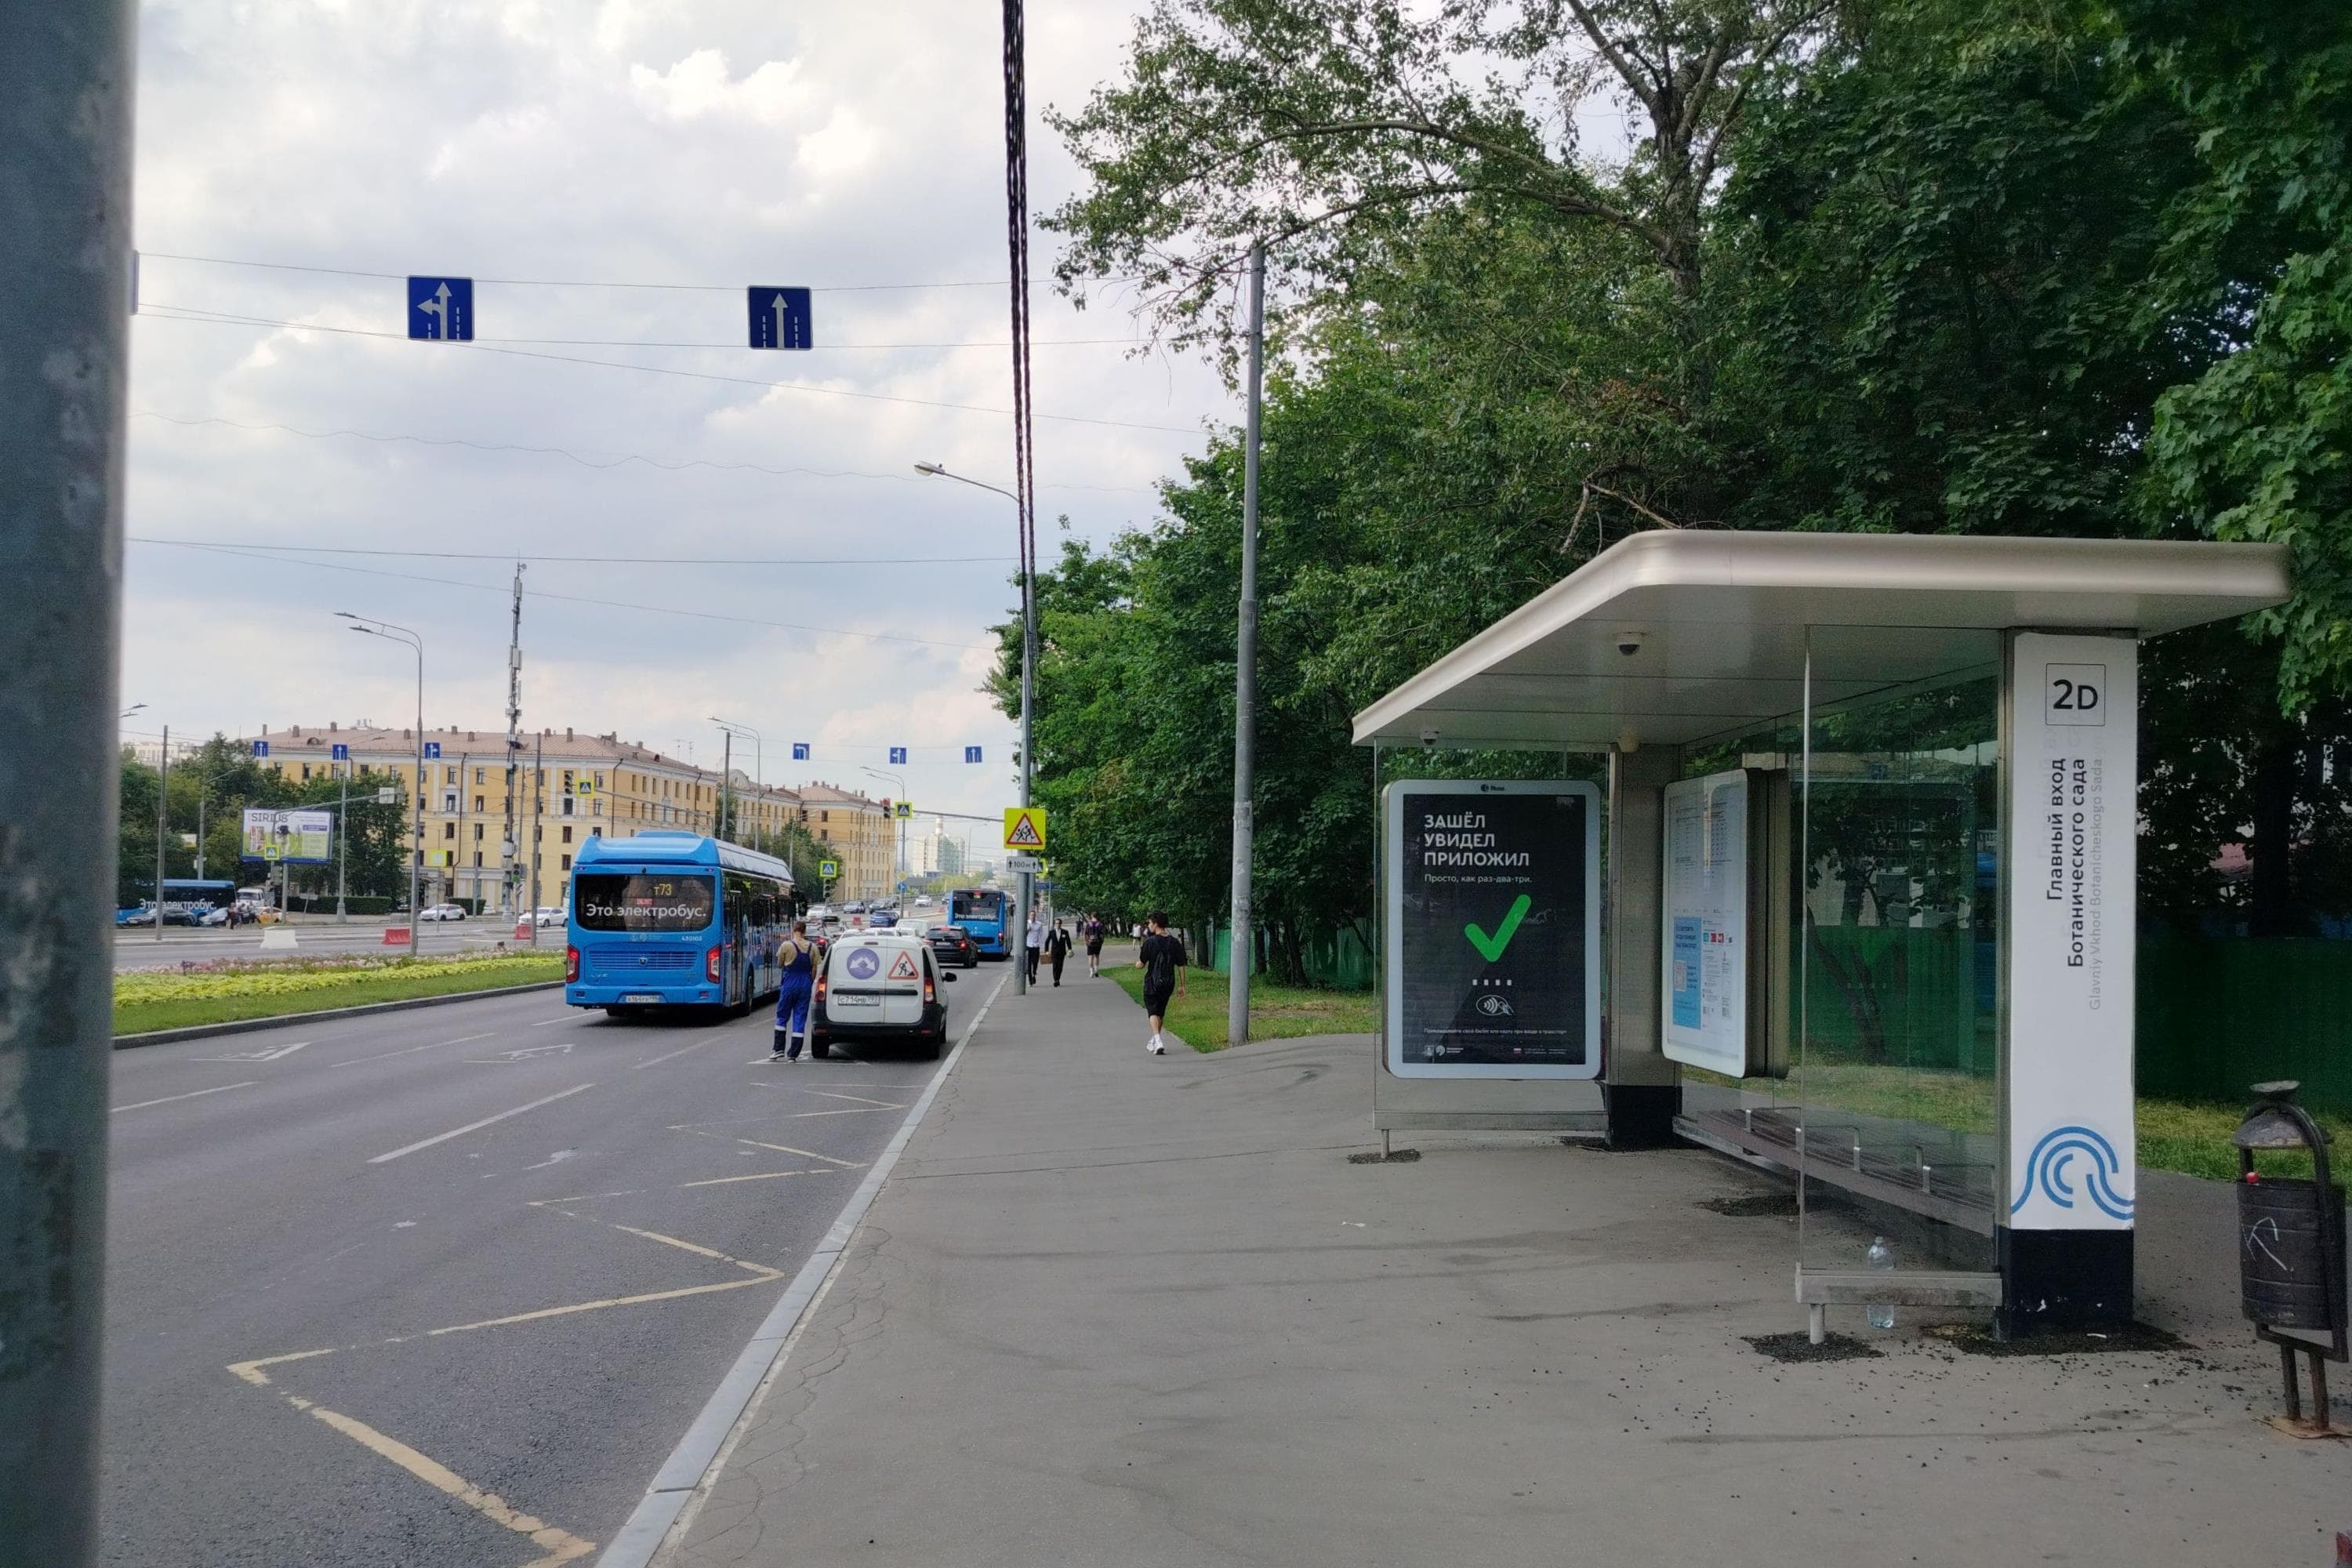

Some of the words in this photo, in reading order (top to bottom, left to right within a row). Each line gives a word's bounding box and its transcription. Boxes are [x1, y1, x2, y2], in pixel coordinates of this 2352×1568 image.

[2053, 679, 2098, 710] 2D
[2052, 758, 2066, 806] вход
[2073, 759, 2087, 806] сада
[2091, 758, 2102, 792] Sada
[1425, 811, 1485, 829] ЗАШЁЛ
[1424, 833, 1495, 849] УВИДЕЛ
[2046, 813, 2063, 900] Главный
[2089, 797, 2104, 906] Botanicheskogo
[1424, 852, 1530, 866] ПРИЛОЖИЛ
[1425, 874, 1459, 883] Просто,
[2067, 812, 2085, 967] Ботанического
[140, 898, 157, 909] Это
[586, 904, 613, 916] Это
[617, 904, 706, 920] электробус.
[2089, 910, 2101, 955] Vkhod
[2089, 958, 2103, 1011] Glavniy
